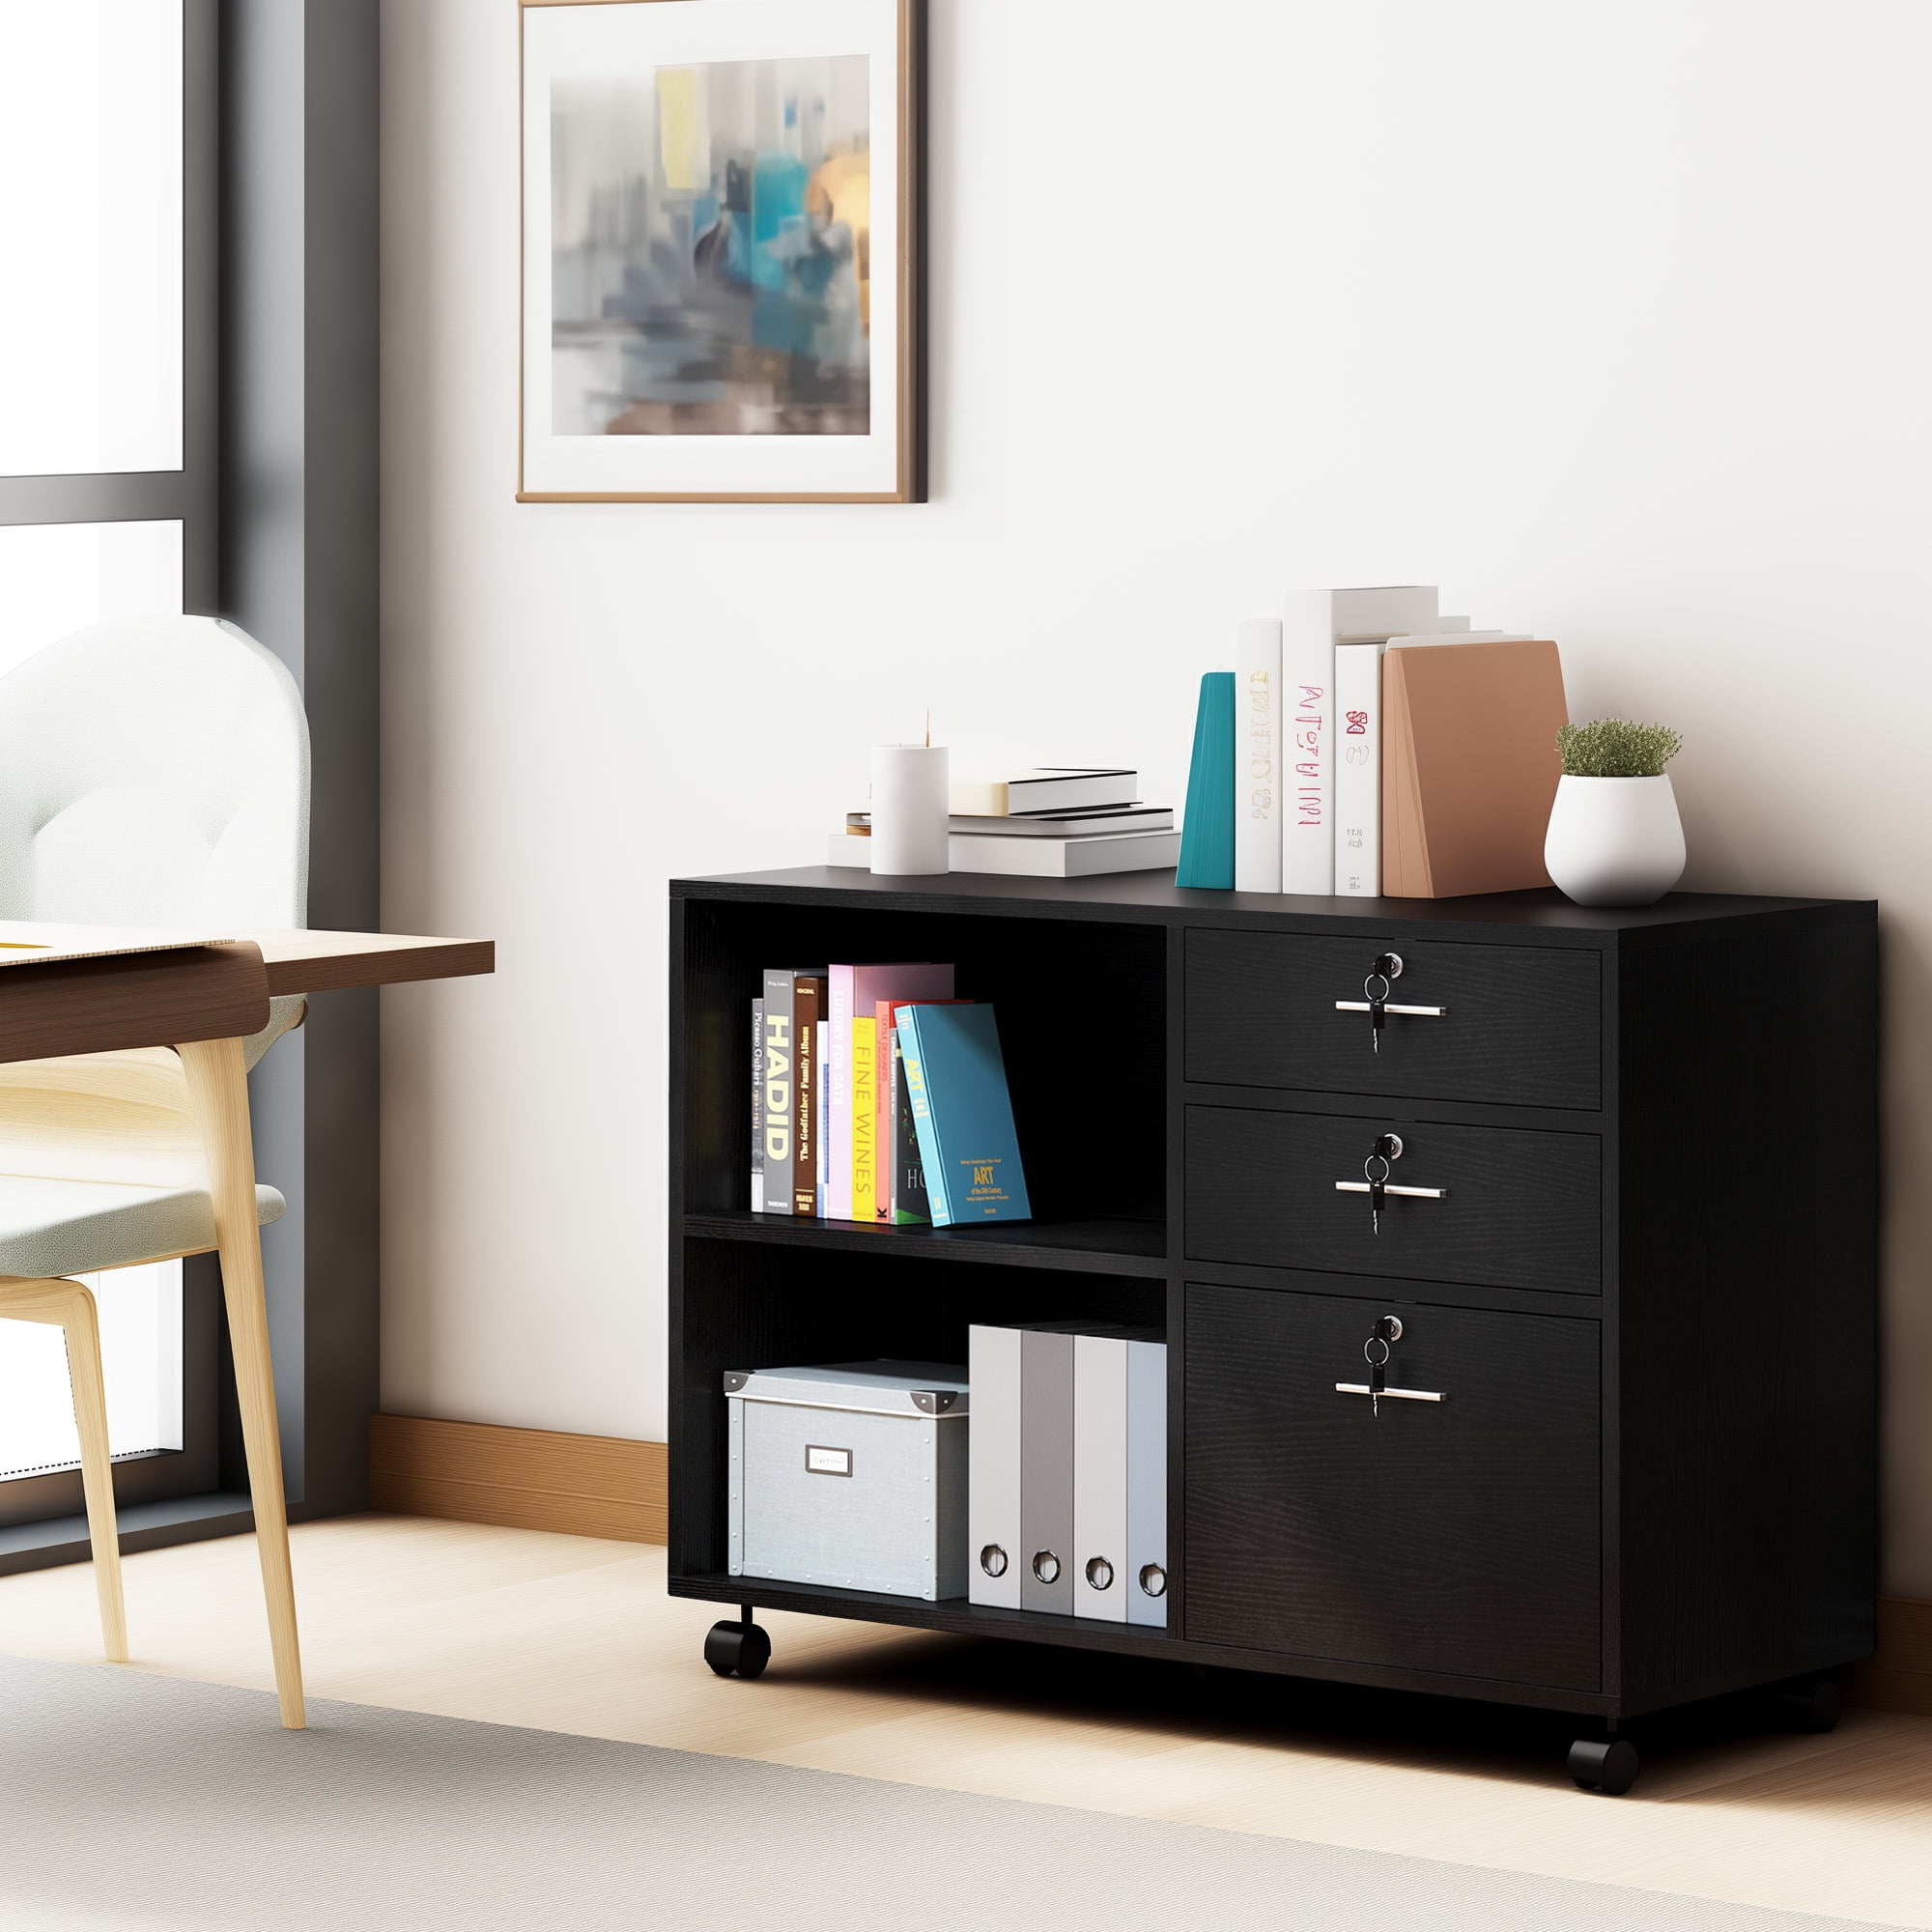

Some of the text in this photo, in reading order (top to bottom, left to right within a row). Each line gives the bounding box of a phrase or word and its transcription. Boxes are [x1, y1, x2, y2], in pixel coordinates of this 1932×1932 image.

[767, 1014, 788, 1161] HADID
[834, 990, 844, 1106] LUXURY FOR CATS
[856, 1046, 871, 1100] FINE
[905, 1059, 923, 1093] ART
[800, 1026, 810, 1162] The Godfather Family Album
[856, 1113, 871, 1194] WINES
[974, 1166, 994, 1184] ART
